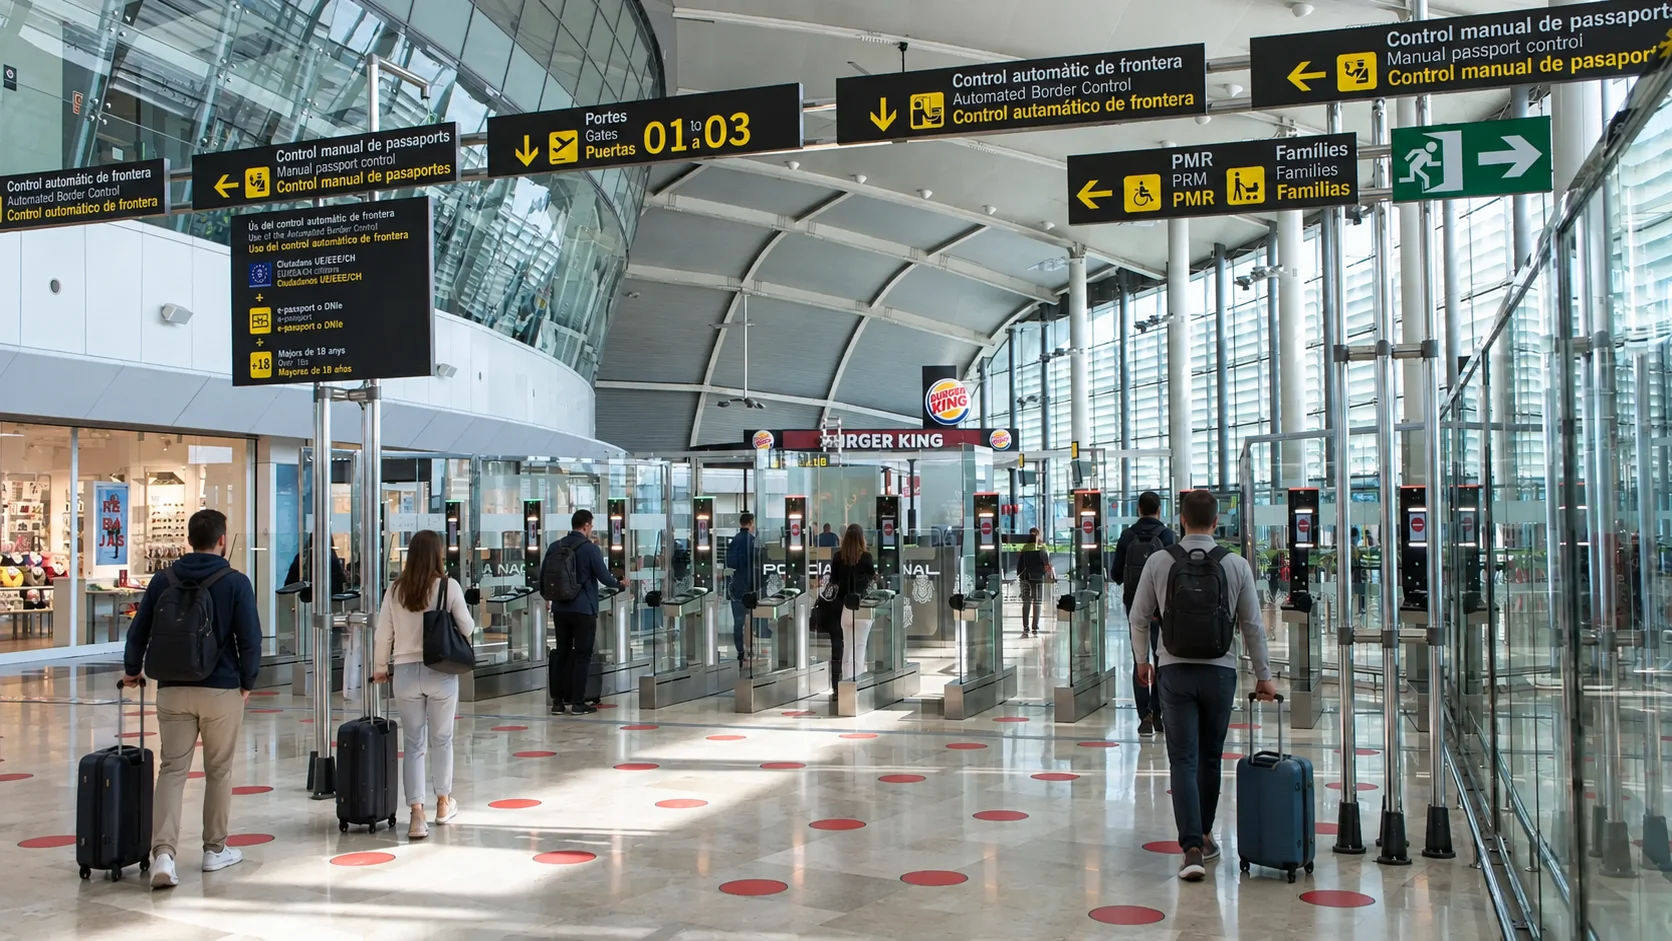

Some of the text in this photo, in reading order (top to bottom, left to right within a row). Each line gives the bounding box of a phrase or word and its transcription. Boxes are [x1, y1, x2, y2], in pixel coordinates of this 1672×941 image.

[1386, 2, 1672, 47] Control manual de passaport
[1387, 46, 1446, 66] Manual
[1452, 39, 1521, 62] passport
[952, 55, 1183, 88] Control automàtic de frontera
[1388, 63, 1454, 86] Control
[1461, 57, 1532, 80] manual
[1539, 53, 1564, 73] de
[953, 77, 1132, 105] Automated Border Control
[585, 111, 627, 126] Portes
[952, 105, 1008, 125] Control
[1105, 96, 1125, 113] de
[1130, 92, 1195, 110] frontera
[585, 129, 618, 143] Gates
[643, 118, 687, 155] 01
[704, 111, 751, 149] 03
[691, 137, 700, 149] a
[276, 129, 450, 163] Control manual de passaports
[585, 143, 636, 160] Puertas
[1275, 142, 1348, 161] Famílies
[277, 153, 396, 178] Manual passport control
[1172, 151, 1213, 170] PMR
[7, 177, 42, 192] Control
[98, 171, 109, 183] de
[112, 168, 151, 182] frontera
[276, 162, 451, 194] Control manual de pasaportes
[1172, 171, 1207, 188] PRM
[1276, 162, 1339, 180] Families
[7, 185, 120, 206] Automated Border Control
[1173, 189, 1215, 208] PMR
[1276, 180, 1351, 201] Familias
[7, 206, 42, 221] Control
[103, 200, 116, 212] de
[119, 196, 158, 211] frontera
[261, 220, 274, 230] del
[276, 217, 304, 228] control
[349, 212, 360, 222] de
[362, 209, 395, 220] frontera
[248, 243, 264, 254] Uso
[266, 240, 279, 252] del
[281, 238, 309, 250] control
[360, 233, 371, 243] de
[374, 231, 409, 242] frontera
[316, 322, 323, 330] o
[304, 347, 314, 356] de
[316, 346, 326, 355] 18
[328, 347, 346, 356] anys
[310, 366, 321, 375] de
[931, 395, 968, 415] KING
[898, 433, 944, 448] KING
[103, 500, 121, 513] RE
[102, 516, 123, 531] BA
[98, 534, 125, 547] JAS
